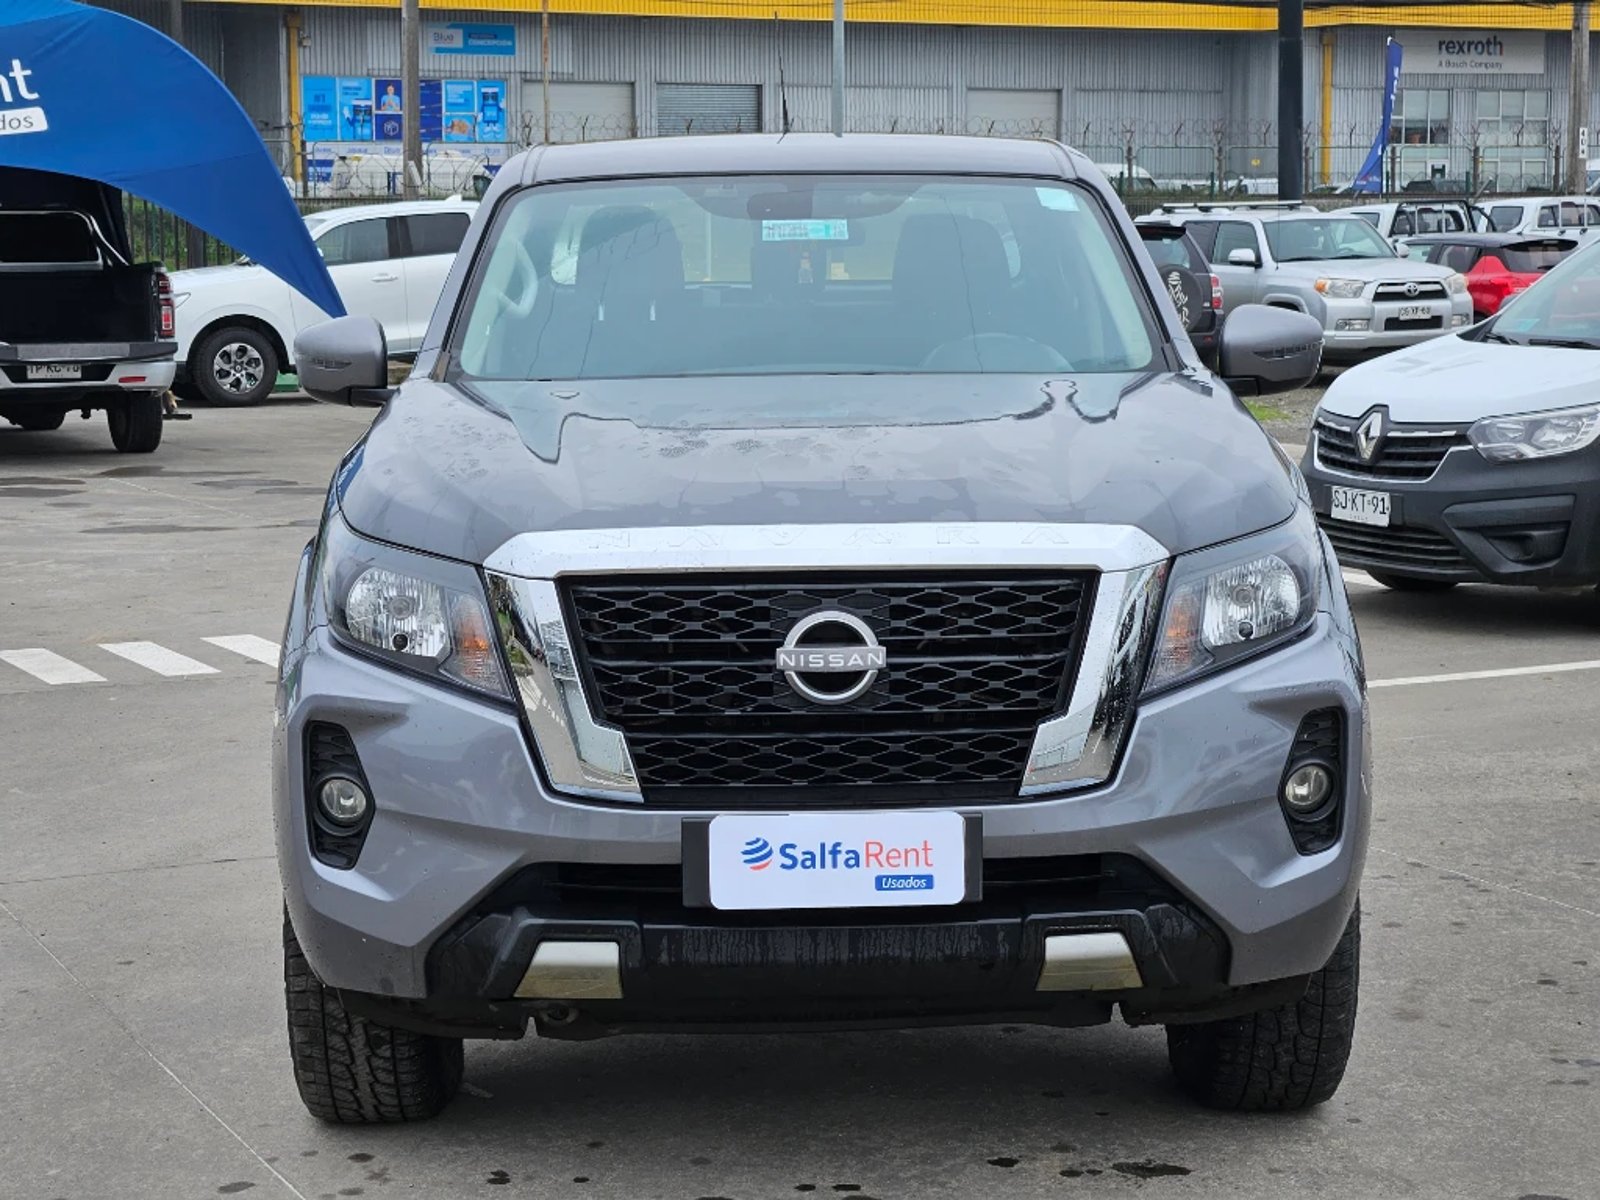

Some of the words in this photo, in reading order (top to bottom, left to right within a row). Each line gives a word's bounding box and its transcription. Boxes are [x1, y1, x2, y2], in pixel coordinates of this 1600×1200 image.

[1438, 35, 1503, 56] rexroth
[1469, 61, 1503, 70] Company
[780, 651, 883, 667] NISSAN
[882, 877, 927, 889] Usados
